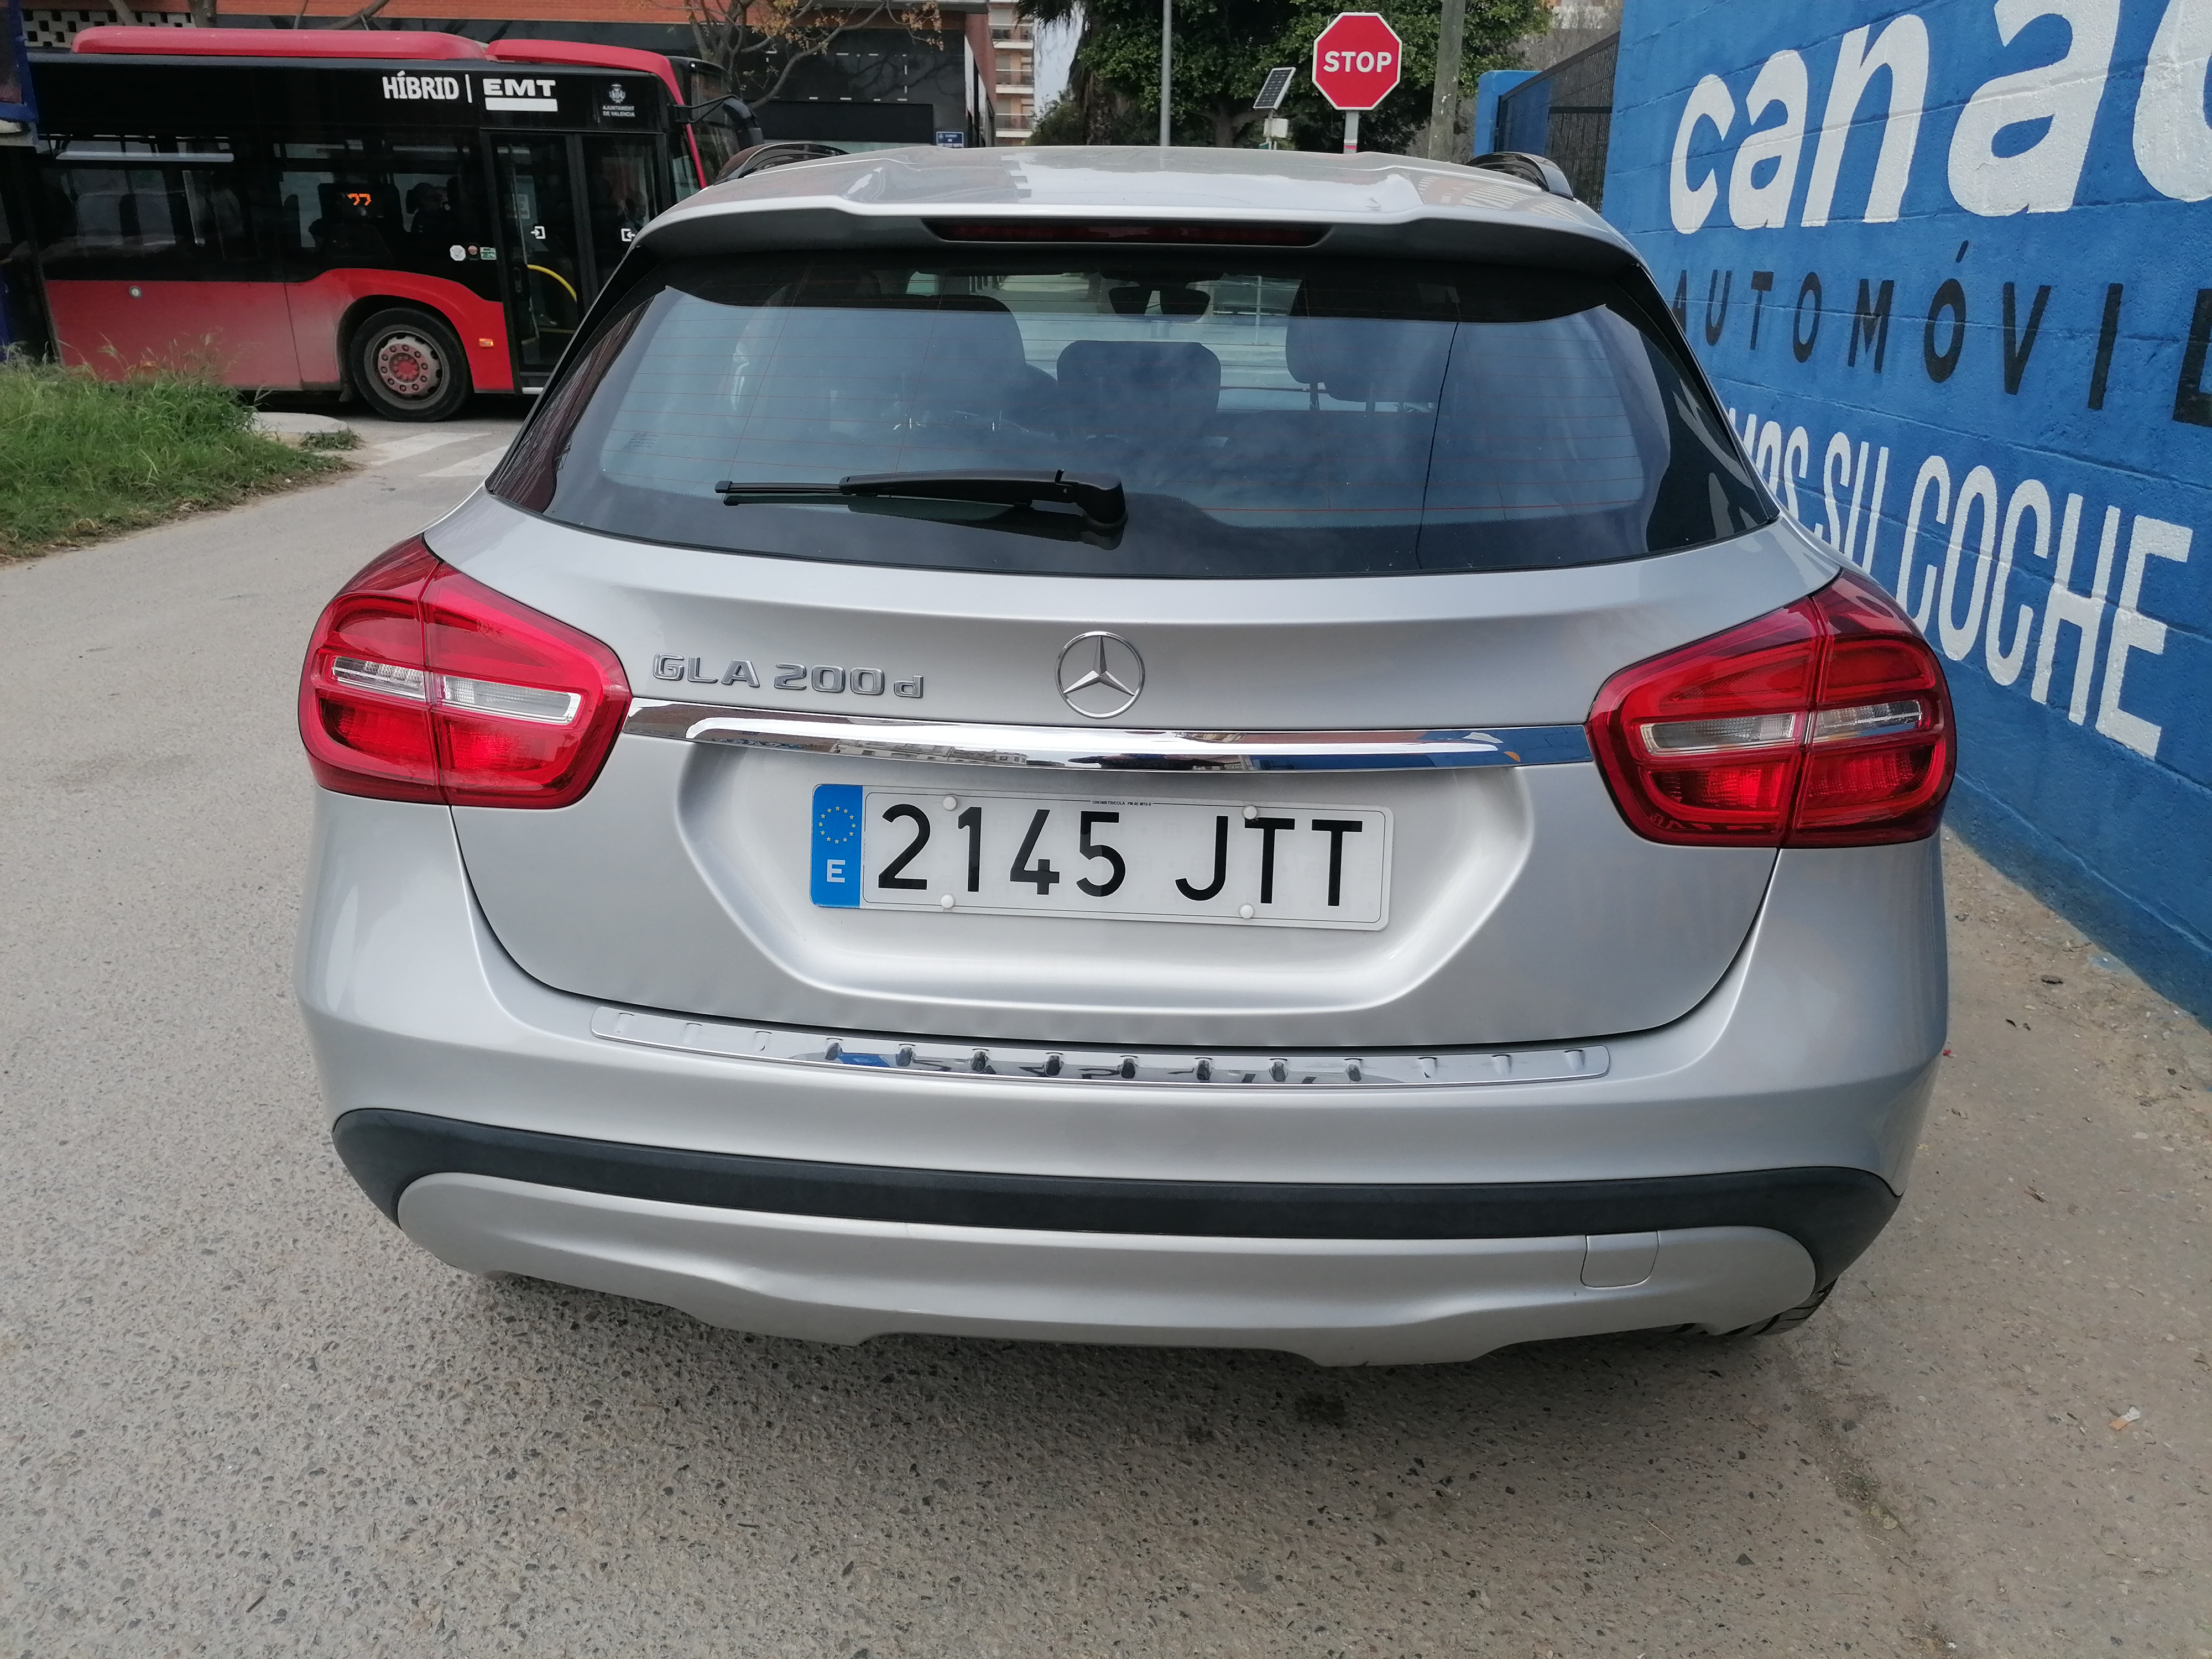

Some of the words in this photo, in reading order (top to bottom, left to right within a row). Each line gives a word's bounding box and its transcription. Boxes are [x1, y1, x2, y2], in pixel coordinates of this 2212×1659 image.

[1323, 50, 1392, 73] STOP
[382, 70, 460, 100] HÍBRID
[482, 78, 556, 97] EMT
[1814, 431, 1889, 575] SU
[1896, 455, 2193, 760] COCHE
[653, 653, 760, 688] GLA
[774, 662, 885, 696] 200
[826, 859, 846, 883] E
[878, 804, 1126, 898] 2145
[1175, 815, 1363, 907] JTT
